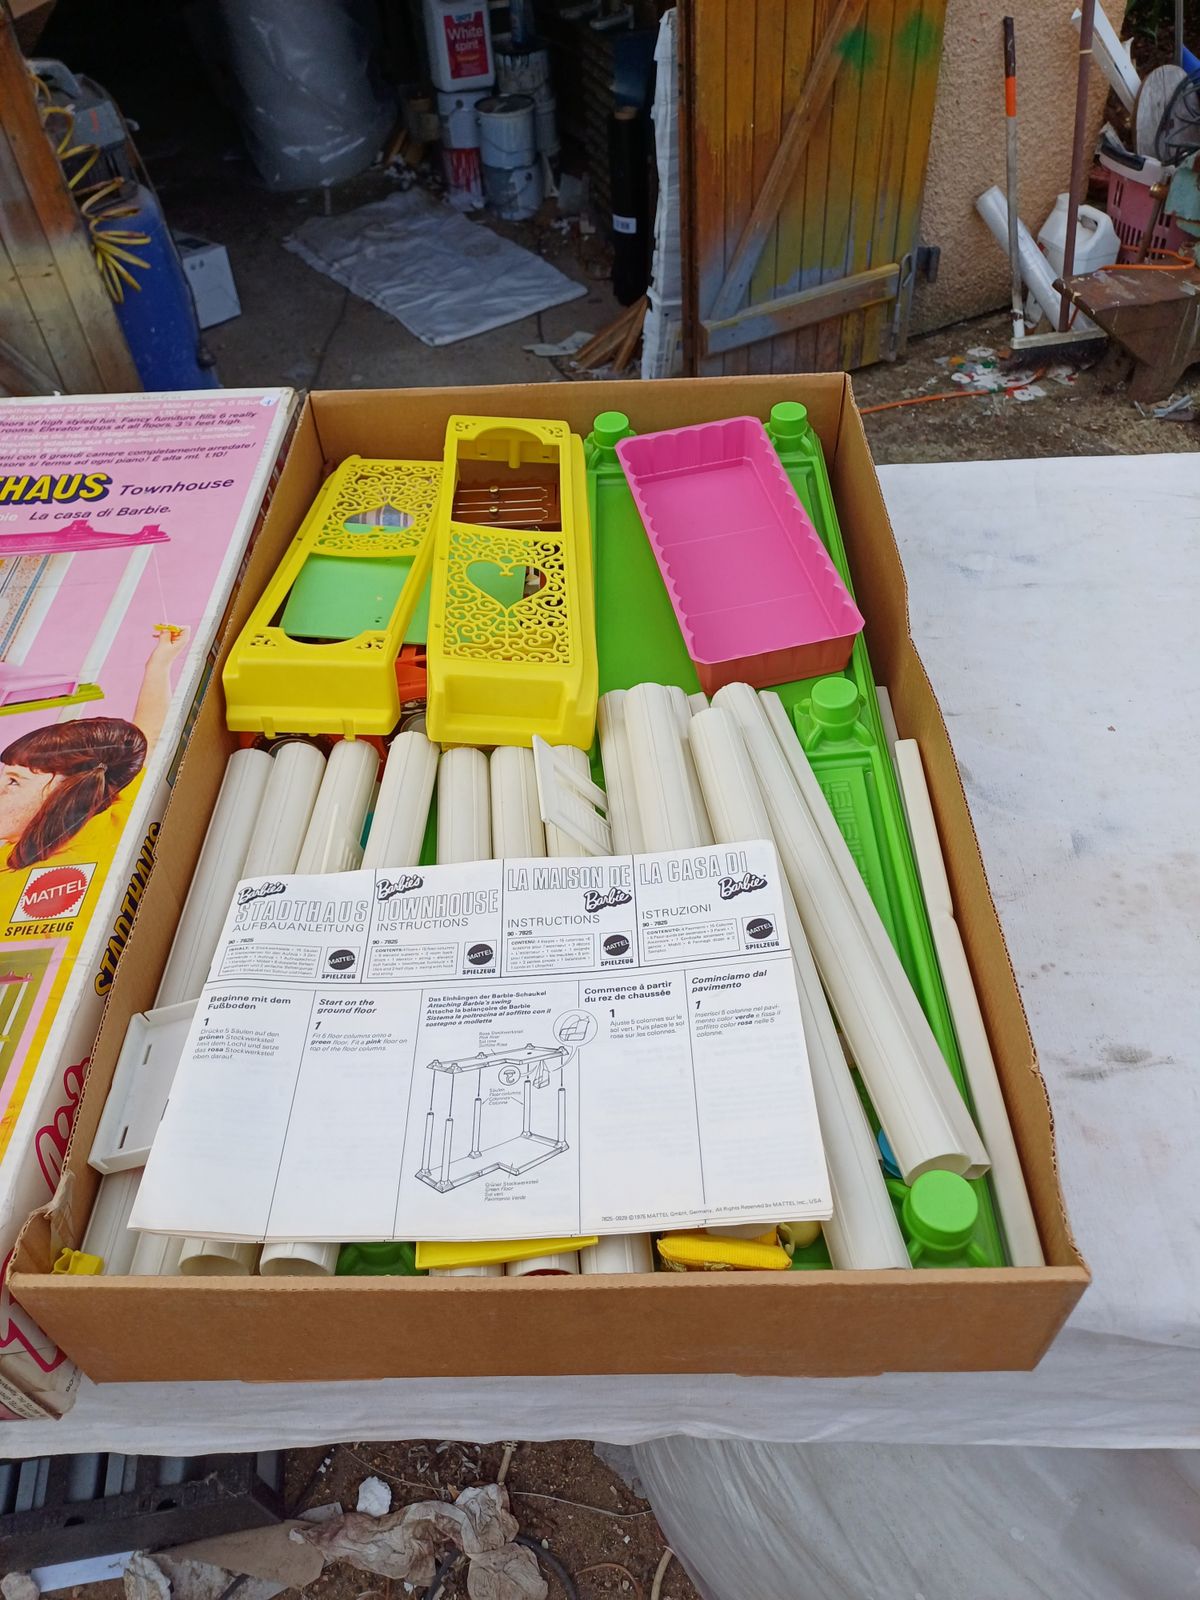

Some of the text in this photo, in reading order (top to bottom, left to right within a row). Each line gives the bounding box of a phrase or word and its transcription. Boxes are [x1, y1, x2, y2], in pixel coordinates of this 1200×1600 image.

[447, 27, 483, 40] White
[121, 416, 151, 424] Fancy
[228, 411, 257, 419] really
[48, 452, 84, 460] grandi
[118, 477, 235, 496] Townhouse
[29, 512, 49, 521] La
[54, 511, 92, 520] casa
[97, 508, 114, 518] di
[116, 504, 172, 517] Barbie.
[639, 851, 748, 885] LA CASA DI
[507, 864, 632, 892] LA MAISON DE
[22, 879, 88, 907] MATTEL
[237, 881, 286, 905] Barbie's
[376, 874, 424, 901] Barbie's
[718, 873, 768, 900] Barbie
[377, 888, 499, 922] TOWNHOUSE
[583, 887, 633, 913] Barbie
[235, 900, 368, 923] STADTHAUS
[642, 903, 712, 920] ISTRUZIONI
[232, 921, 365, 933] AUFBAUANLEITUNG
[376, 918, 469, 932] INSTRUCTIONS
[507, 914, 600, 929] INSTRUCTIONS
[4, 922, 74, 936] SPIELZEUG
[746, 923, 775, 936] MATTEL
[603, 939, 631, 952] MATTEL
[745, 941, 780, 951] SPIELZEUG
[327, 954, 356, 965] MATTEL
[467, 950, 494, 961] MATTEL
[600, 958, 634, 967] SPIELZEUG
[461, 967, 496, 976] SPIELZEUG
[692, 970, 768, 985] Cominciamo dal
[584, 985, 638, 995] Commence
[647, 981, 673, 991] partir
[692, 982, 742, 994] pavimento
[210, 994, 291, 1005] Beginne mit dem
[318, 998, 343, 1006] Start
[443, 994, 478, 1003] Einhängen
[584, 995, 597, 1003] du
[614, 992, 626, 1000] de
[627, 989, 672, 999] chaussée
[207, 1001, 256, 1010] Fußboden
[317, 1007, 352, 1015] ground
[427, 1001, 462, 1009] Attaching
[695, 1000, 701, 1009] 1
[609, 1009, 615, 1018] 1
[735, 1013, 755, 1021] verde
[203, 1017, 210, 1026] 1
[314, 1021, 321, 1030] 1
[366, 1038, 382, 1046] pink
